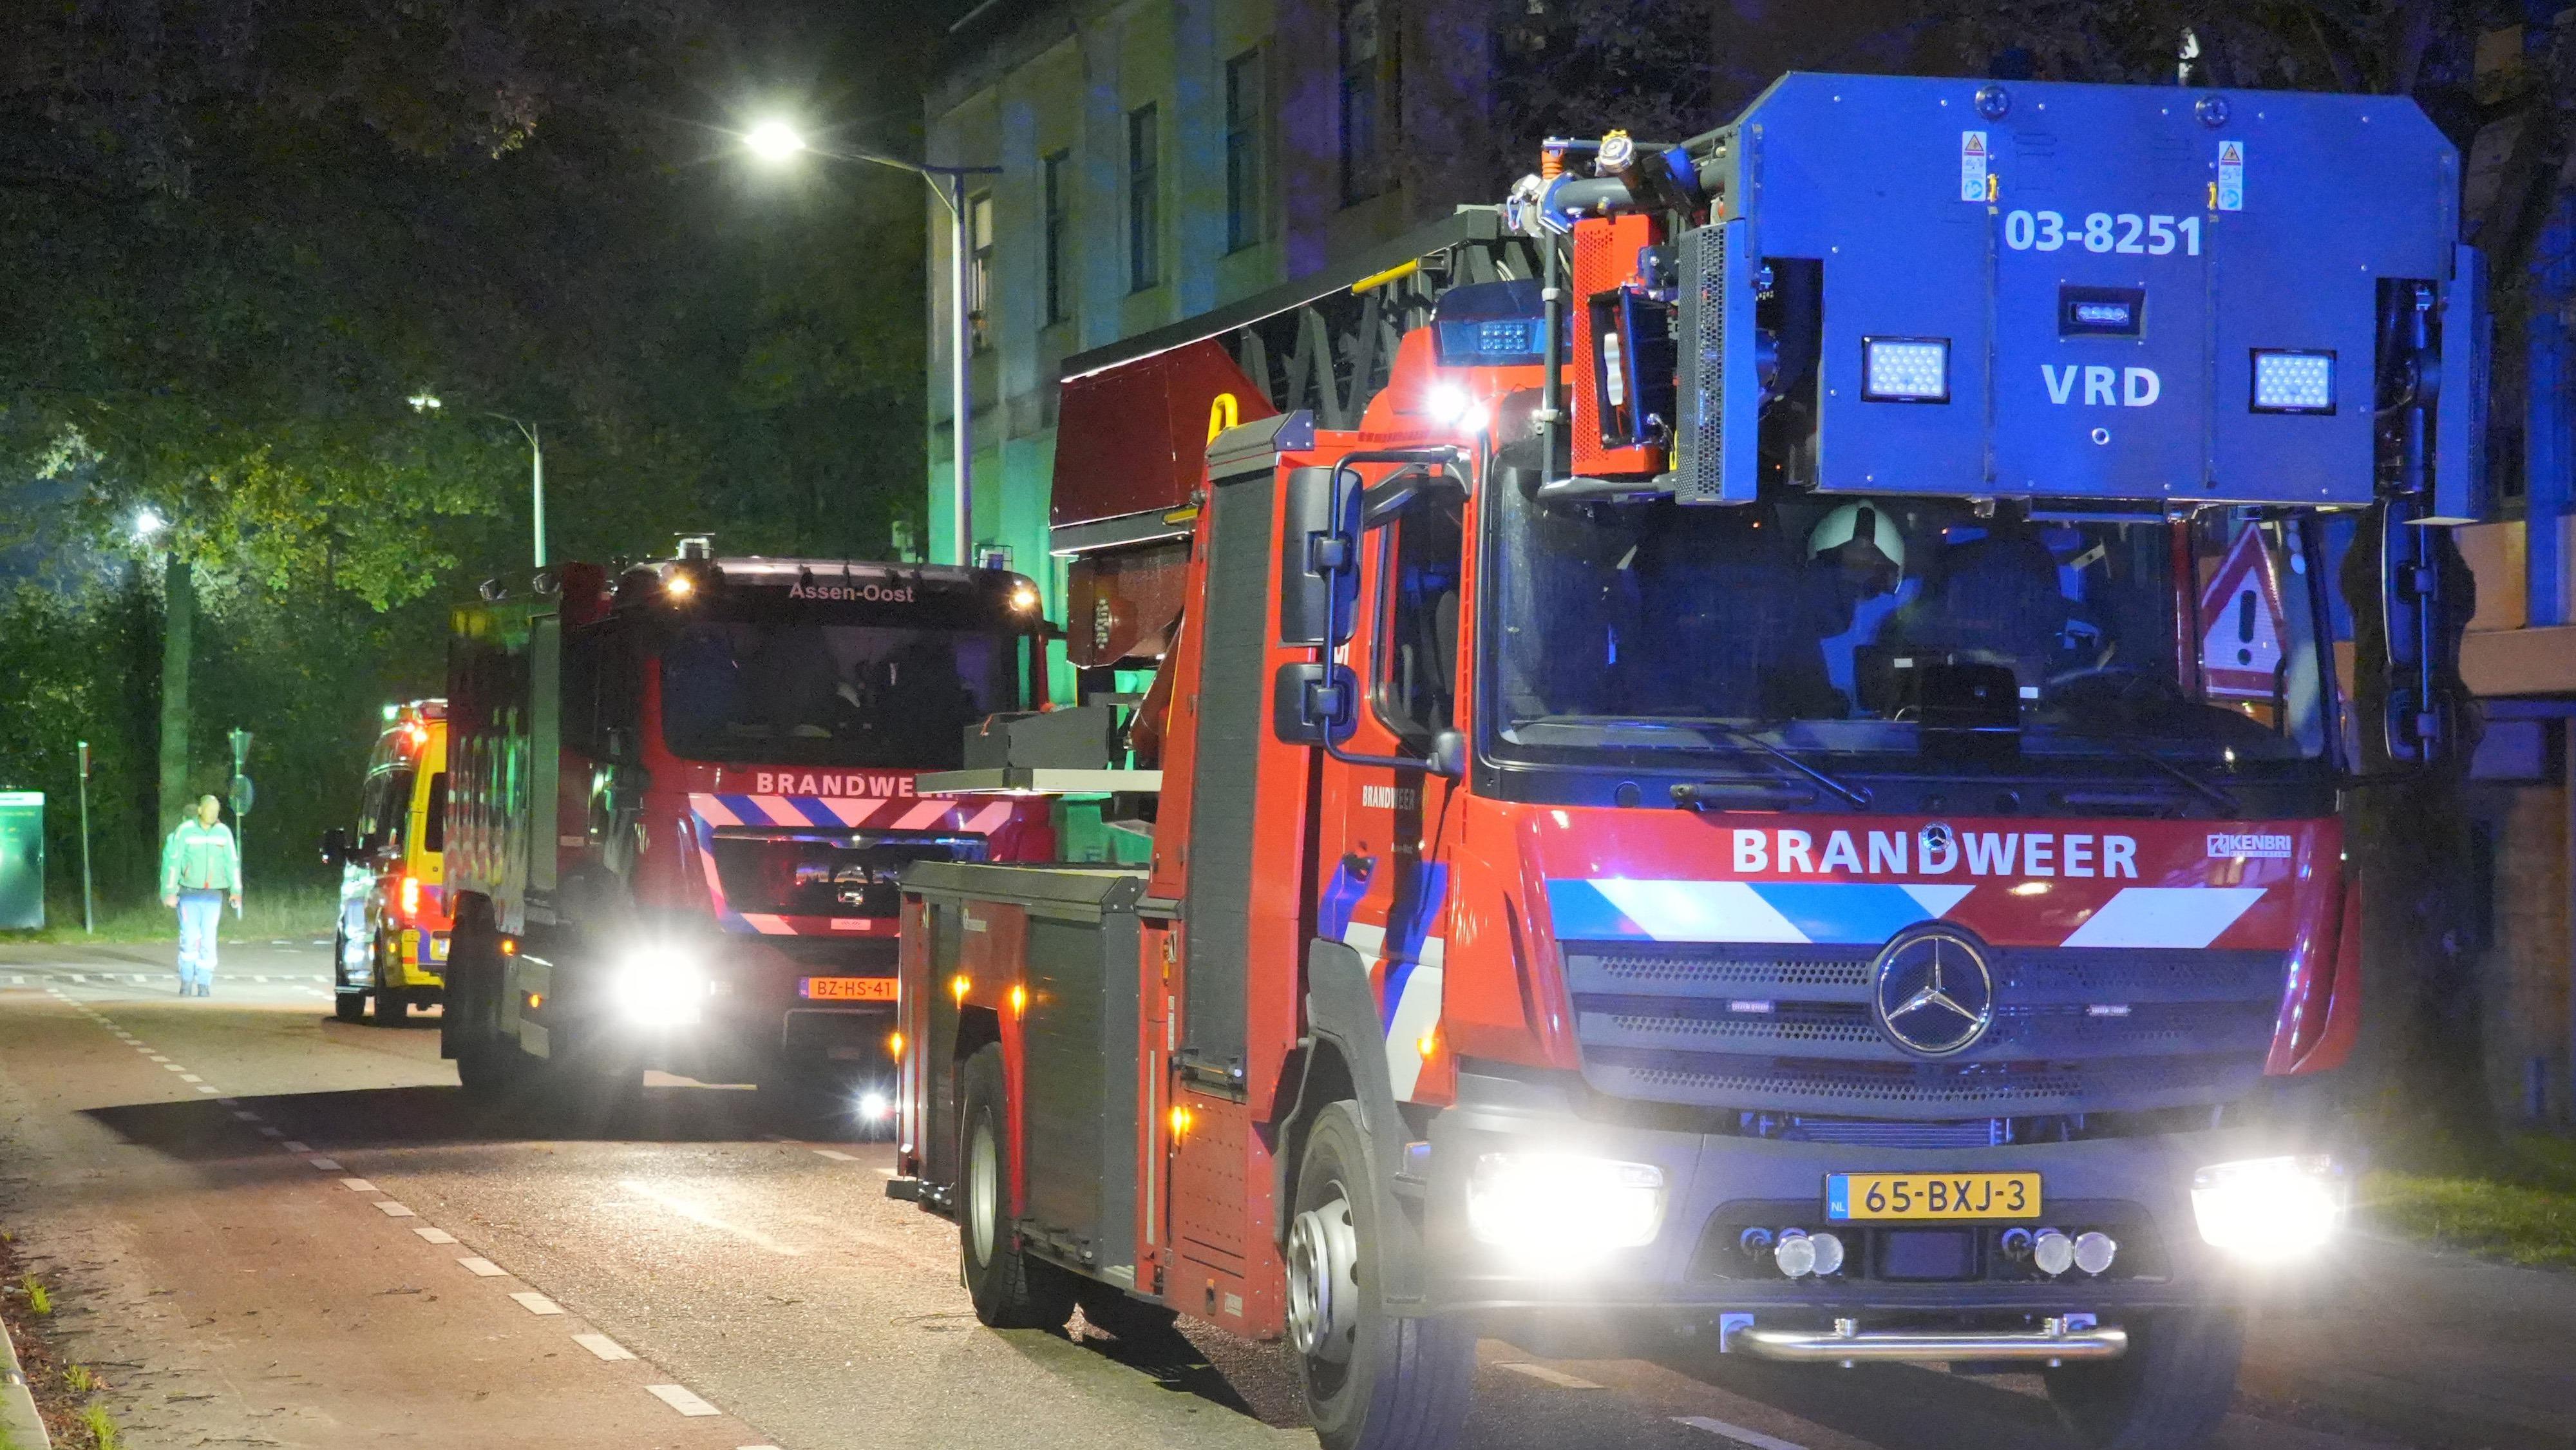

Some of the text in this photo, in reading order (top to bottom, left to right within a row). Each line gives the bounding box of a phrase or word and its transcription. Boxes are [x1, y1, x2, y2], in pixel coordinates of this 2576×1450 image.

[2005, 210, 2199, 256] 03-8251
[2041, 364, 2160, 407] VRD
[789, 582, 914, 603] Assen-Oost
[757, 773, 953, 798] BRANDWE
[1733, 829, 2138, 879] BRANDWEER
[2230, 835, 2291, 850] KENBRI
[817, 981, 890, 996] BZ-HS-41
[1831, 1179, 2025, 1212] NL 65-BXJ-3
